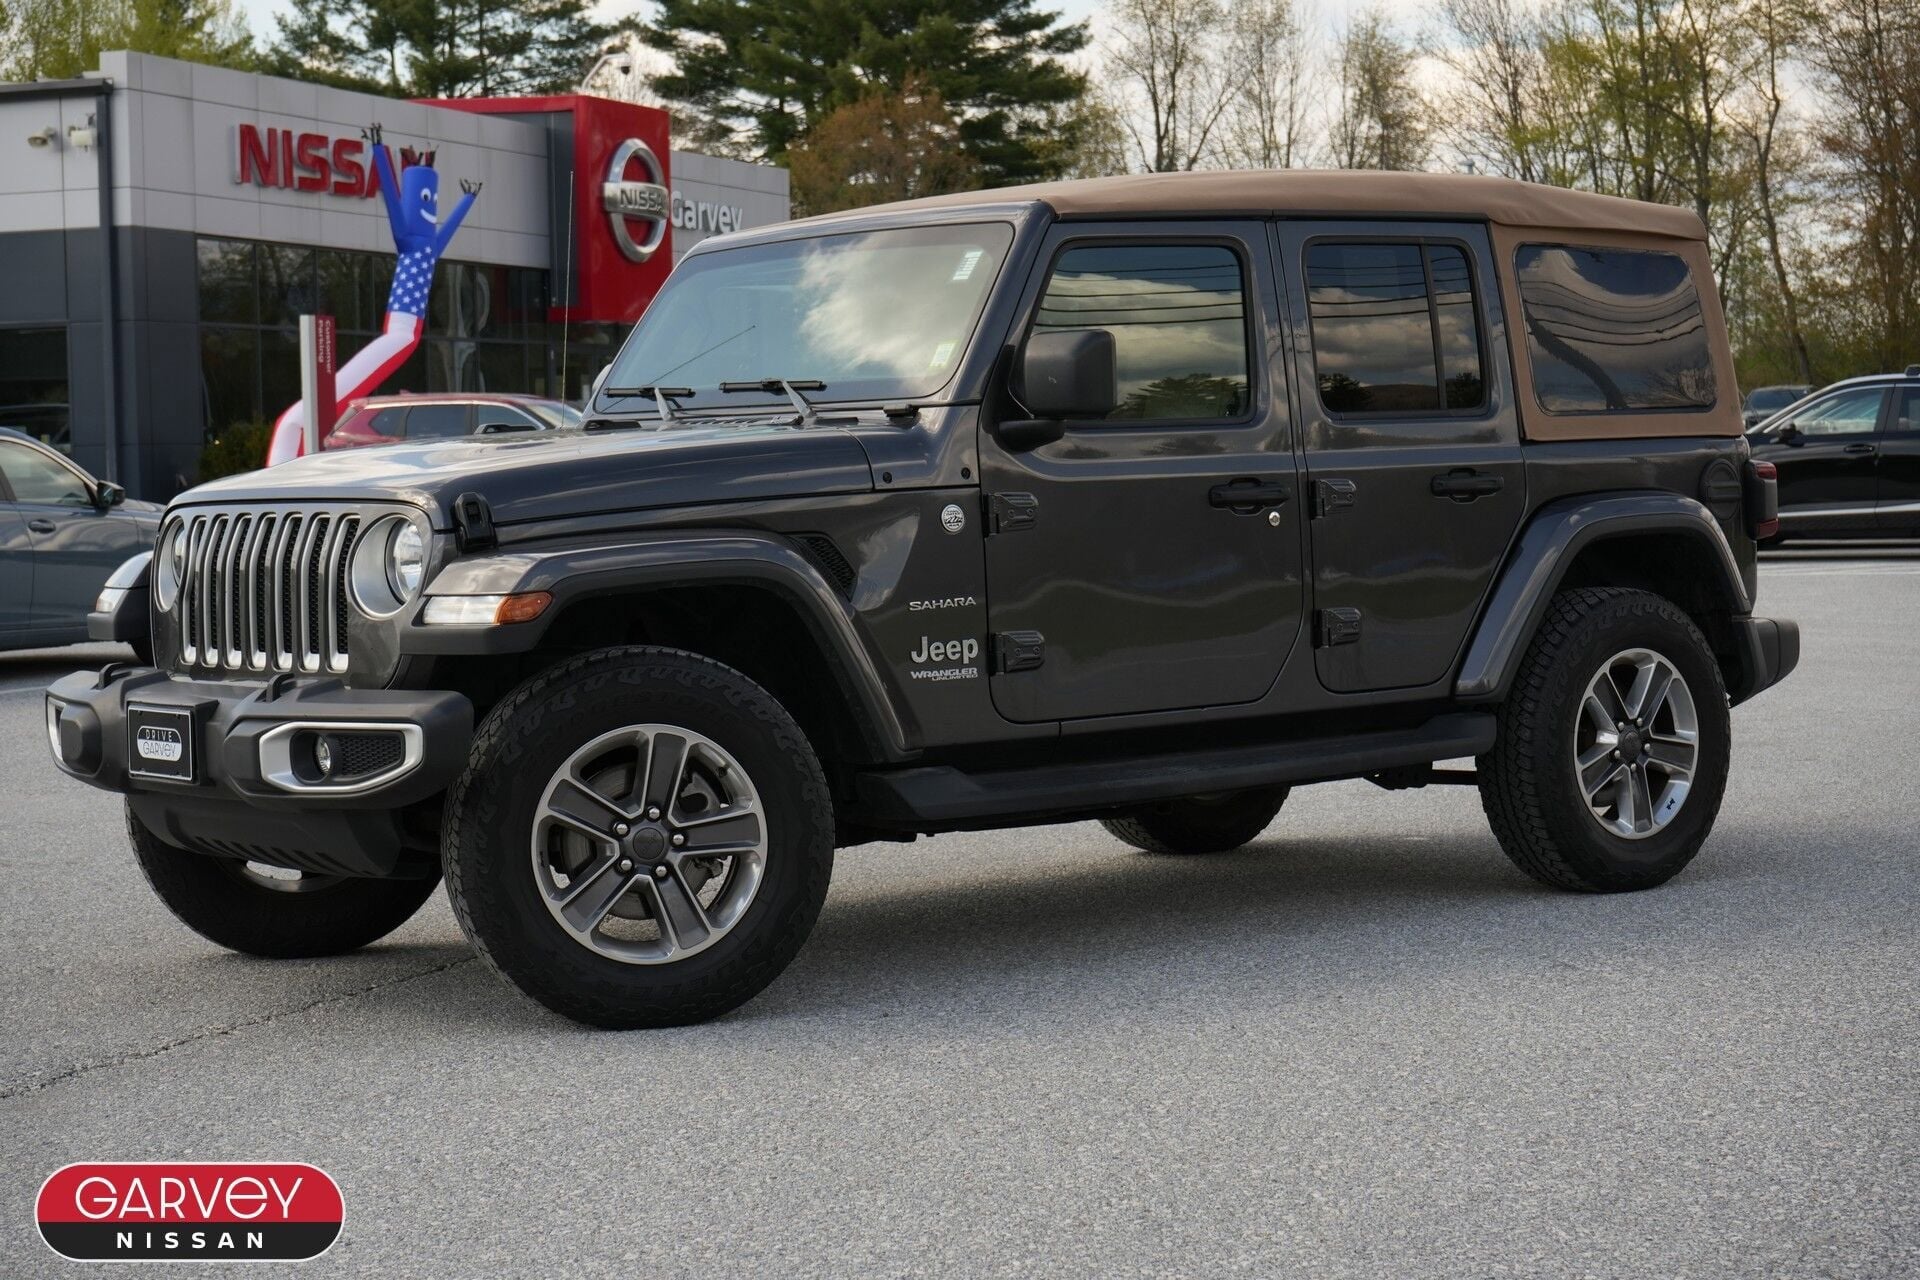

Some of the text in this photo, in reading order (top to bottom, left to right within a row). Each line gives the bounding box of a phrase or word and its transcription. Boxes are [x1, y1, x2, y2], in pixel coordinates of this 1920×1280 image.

[671, 190, 743, 234] Garvey
[909, 596, 977, 611] SAHARA
[911, 636, 979, 664] Jeep
[910, 667, 978, 679] WRANGLER
[145, 729, 173, 742] DRIVE
